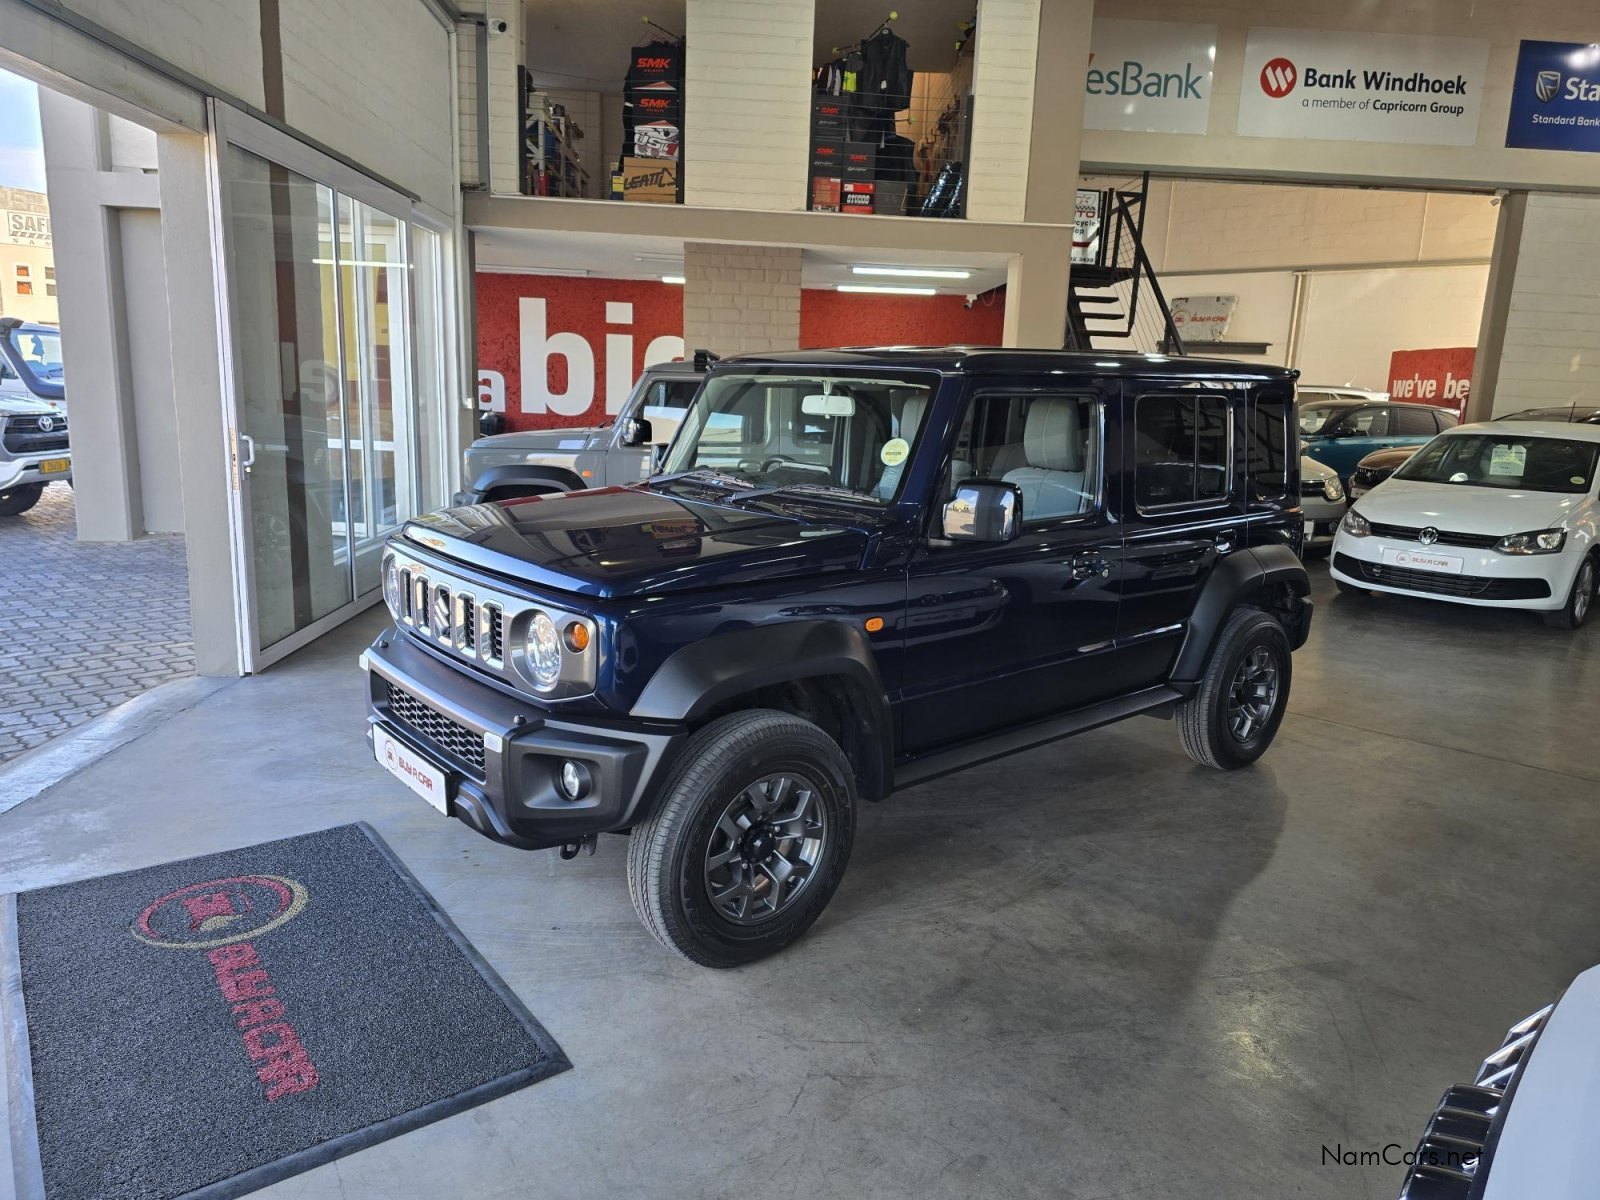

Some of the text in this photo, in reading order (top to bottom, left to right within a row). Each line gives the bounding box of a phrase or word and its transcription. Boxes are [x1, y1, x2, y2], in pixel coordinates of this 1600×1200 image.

[636, 57, 671, 69] SMK
[1086, 53, 1203, 99] esBank
[1303, 68, 1467, 95] Bank Windhoek
[639, 97, 671, 109] SMK
[1302, 97, 1464, 117] a member of Capricorn Group
[1532, 113, 1600, 127] Standard Bank
[1075, 210, 1096, 219] TO
[1073, 220, 1096, 228] cycle
[1392, 373, 1437, 398] we've
[412, 768, 418, 780] A
[417, 771, 433, 791] CAR
